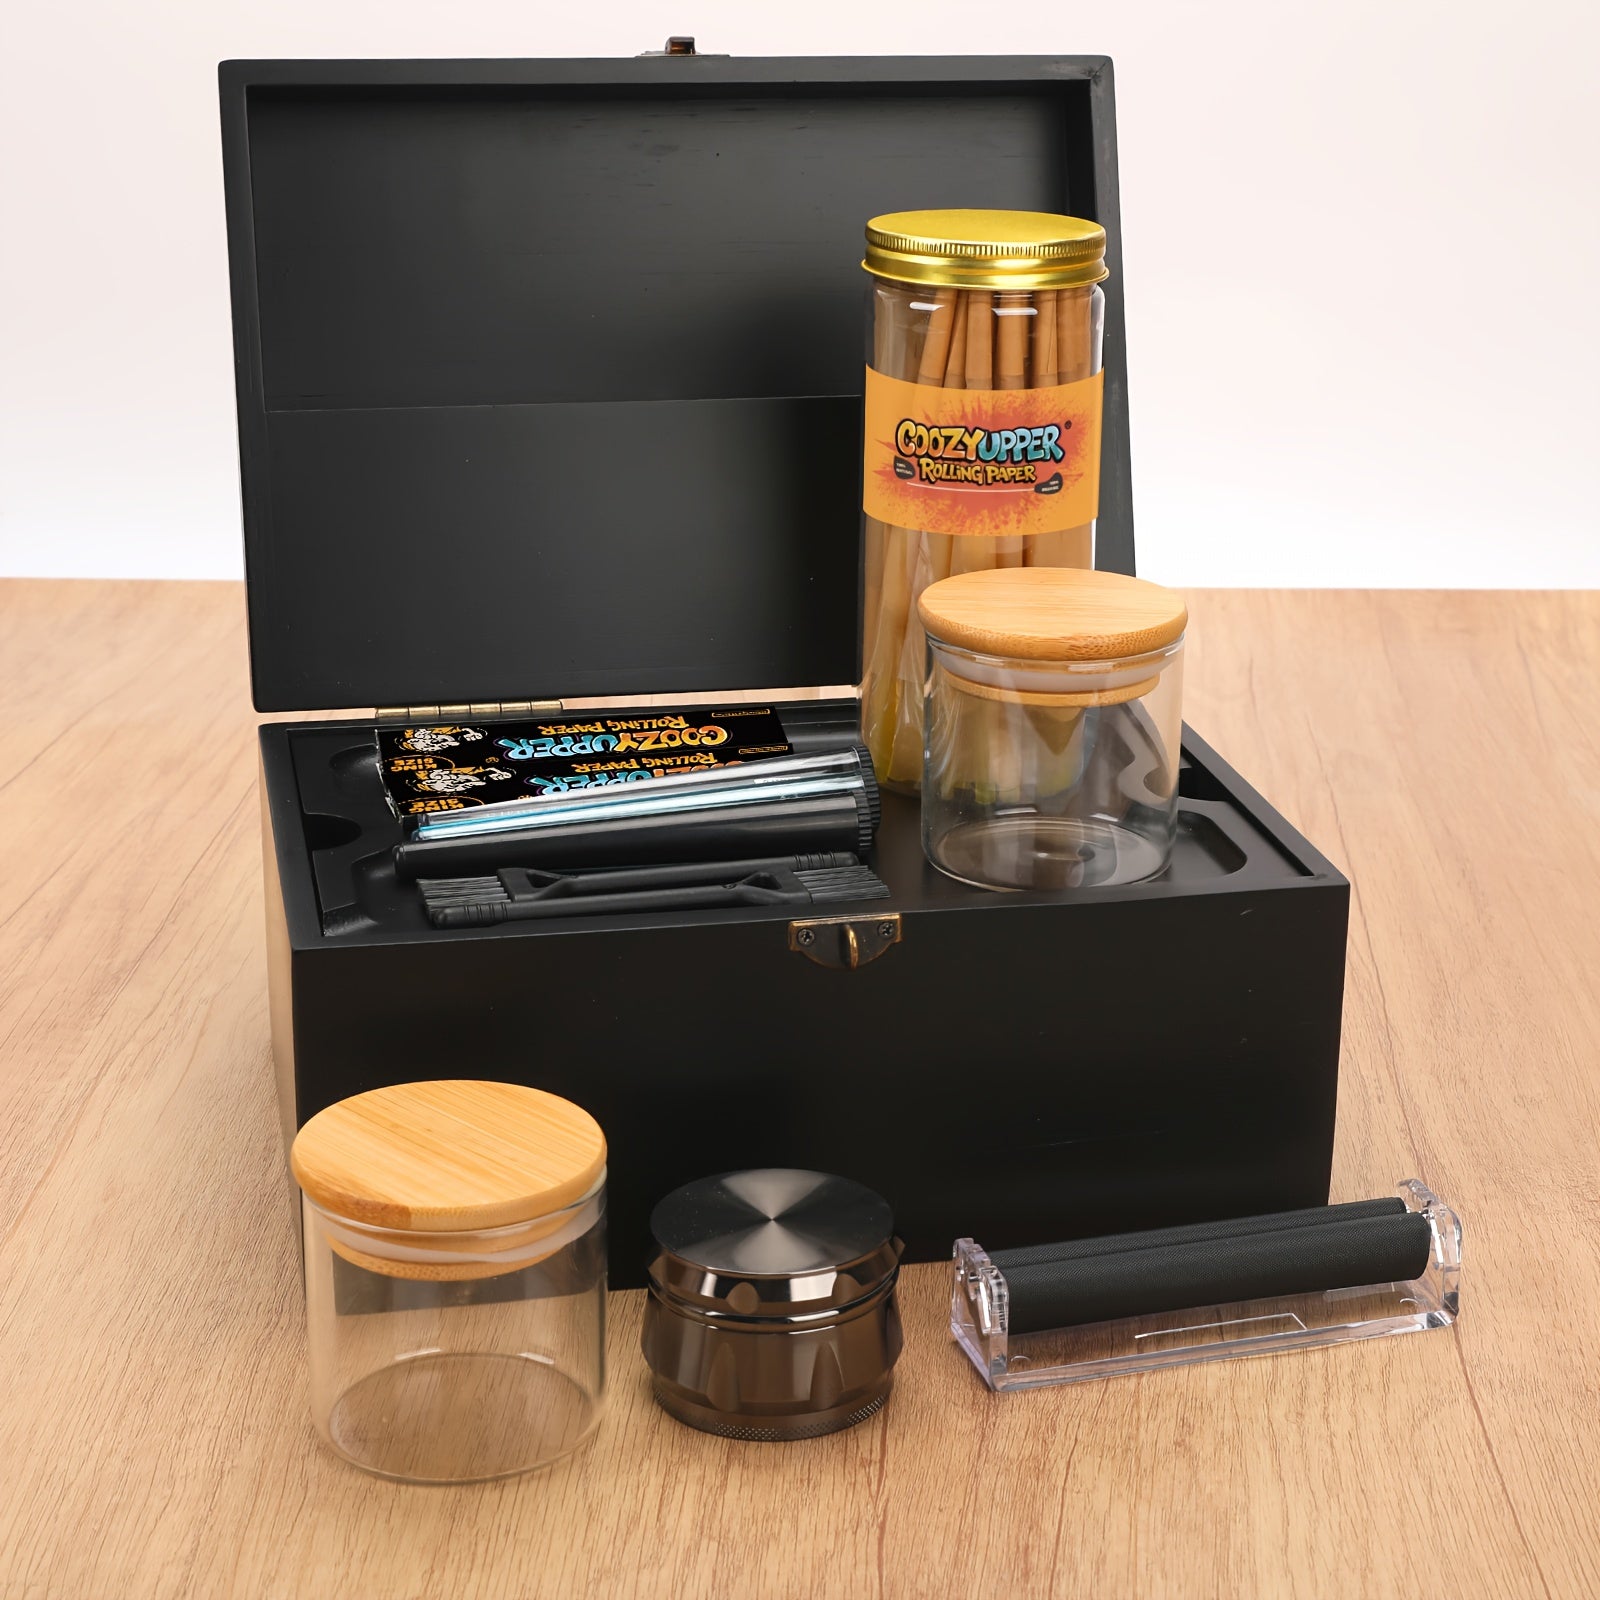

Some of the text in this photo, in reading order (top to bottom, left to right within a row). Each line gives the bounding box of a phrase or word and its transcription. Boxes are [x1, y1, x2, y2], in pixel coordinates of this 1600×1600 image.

[985, 464, 1037, 485] PAPER
[537, 721, 606, 736] PAPER
[571, 758, 641, 773] PAPER
